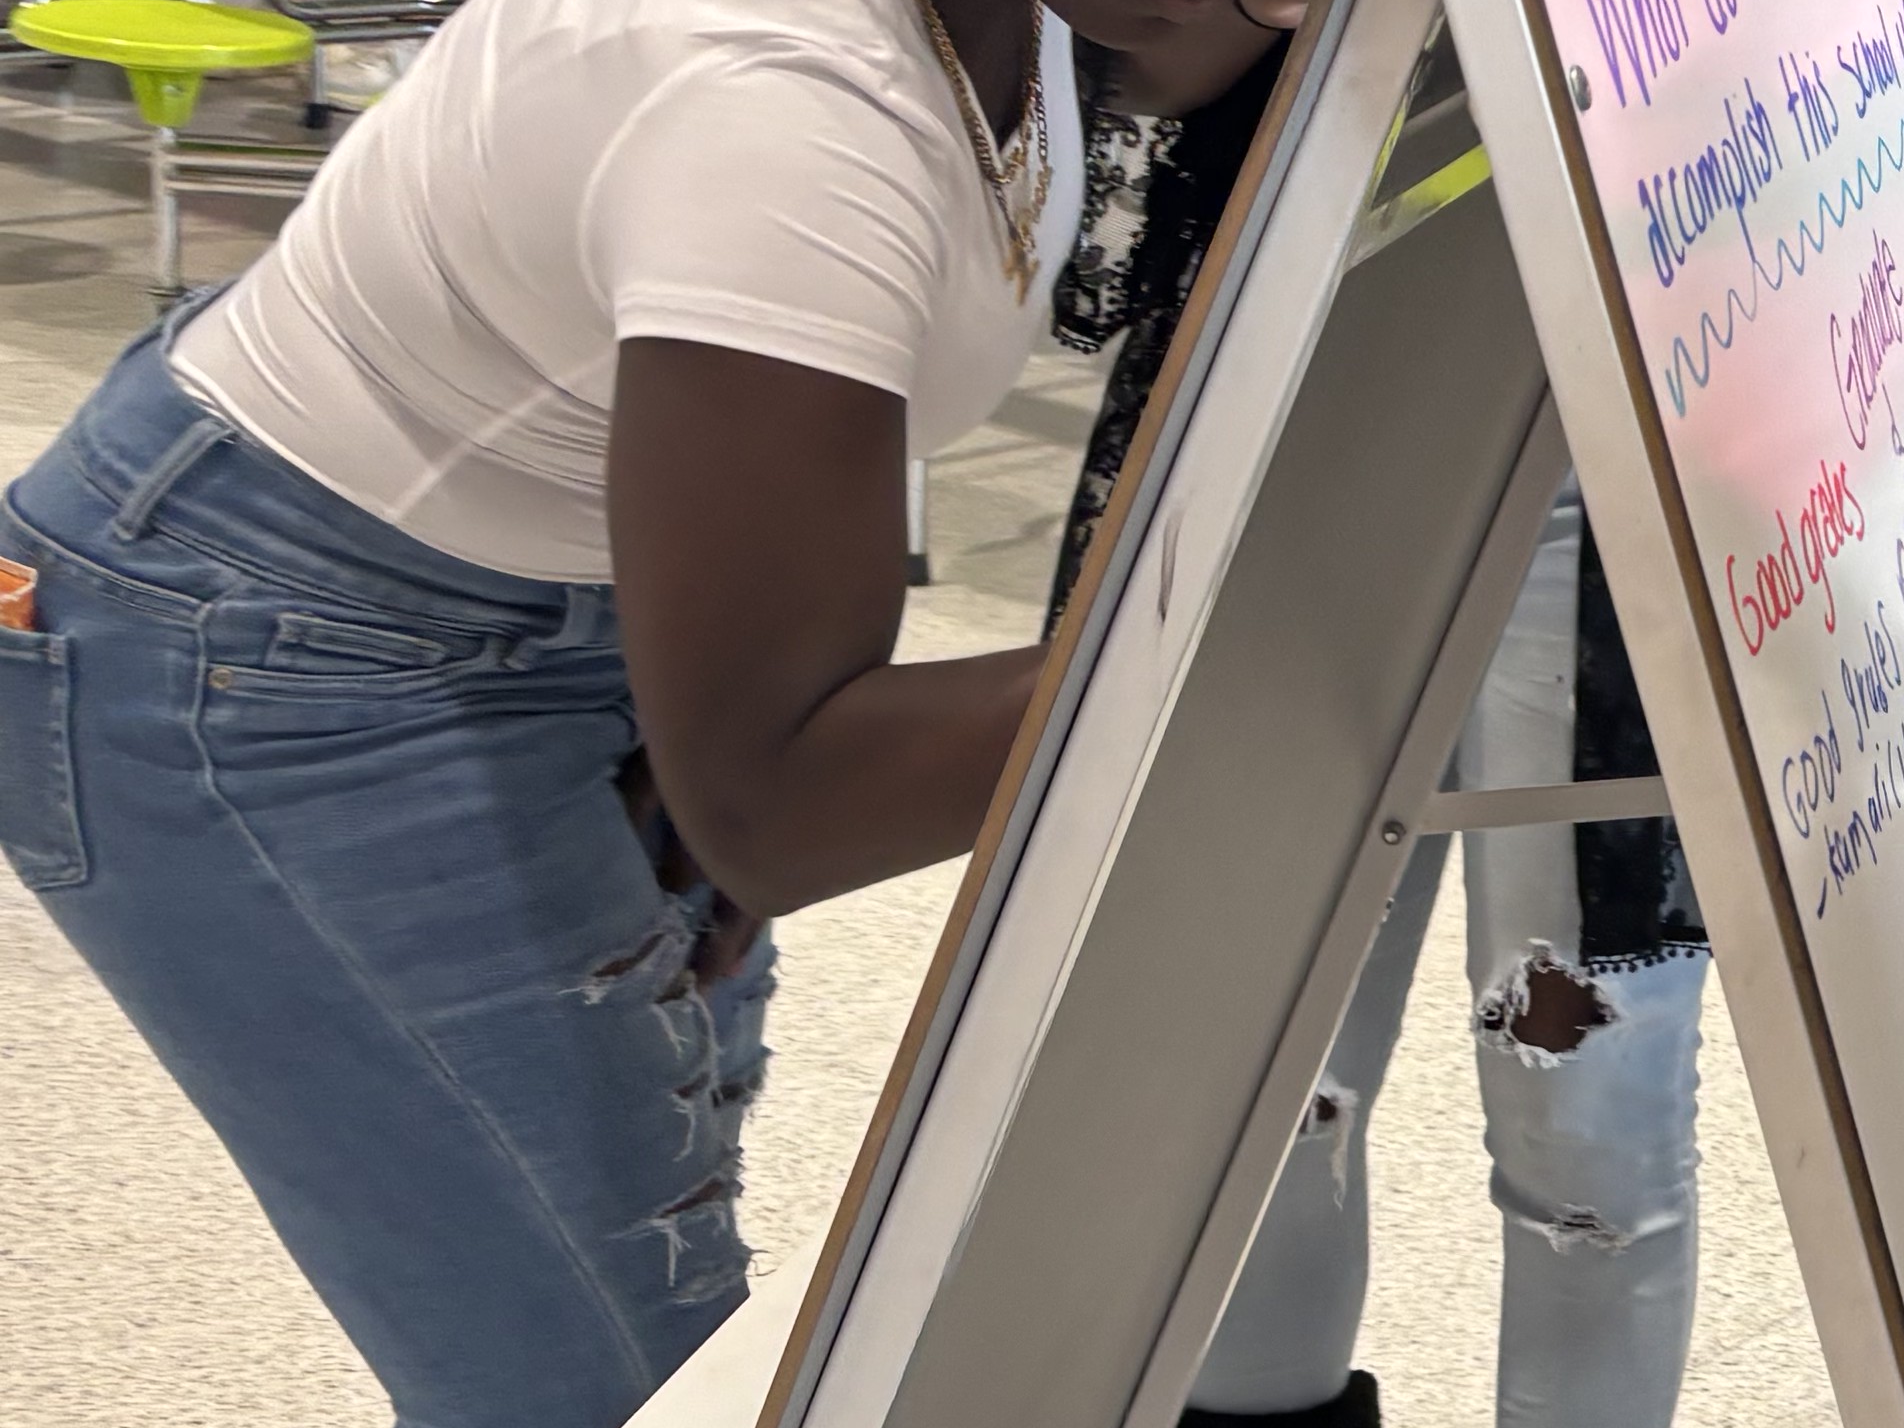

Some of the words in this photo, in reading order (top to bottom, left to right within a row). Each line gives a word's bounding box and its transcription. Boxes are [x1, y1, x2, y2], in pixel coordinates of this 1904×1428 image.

[1635, 77, 1783, 290] accomplish
[1779, 49, 1840, 163] this
[1837, 4, 1899, 121] school
[1726, 510, 1806, 656] Good
[1798, 458, 1866, 635] grades
